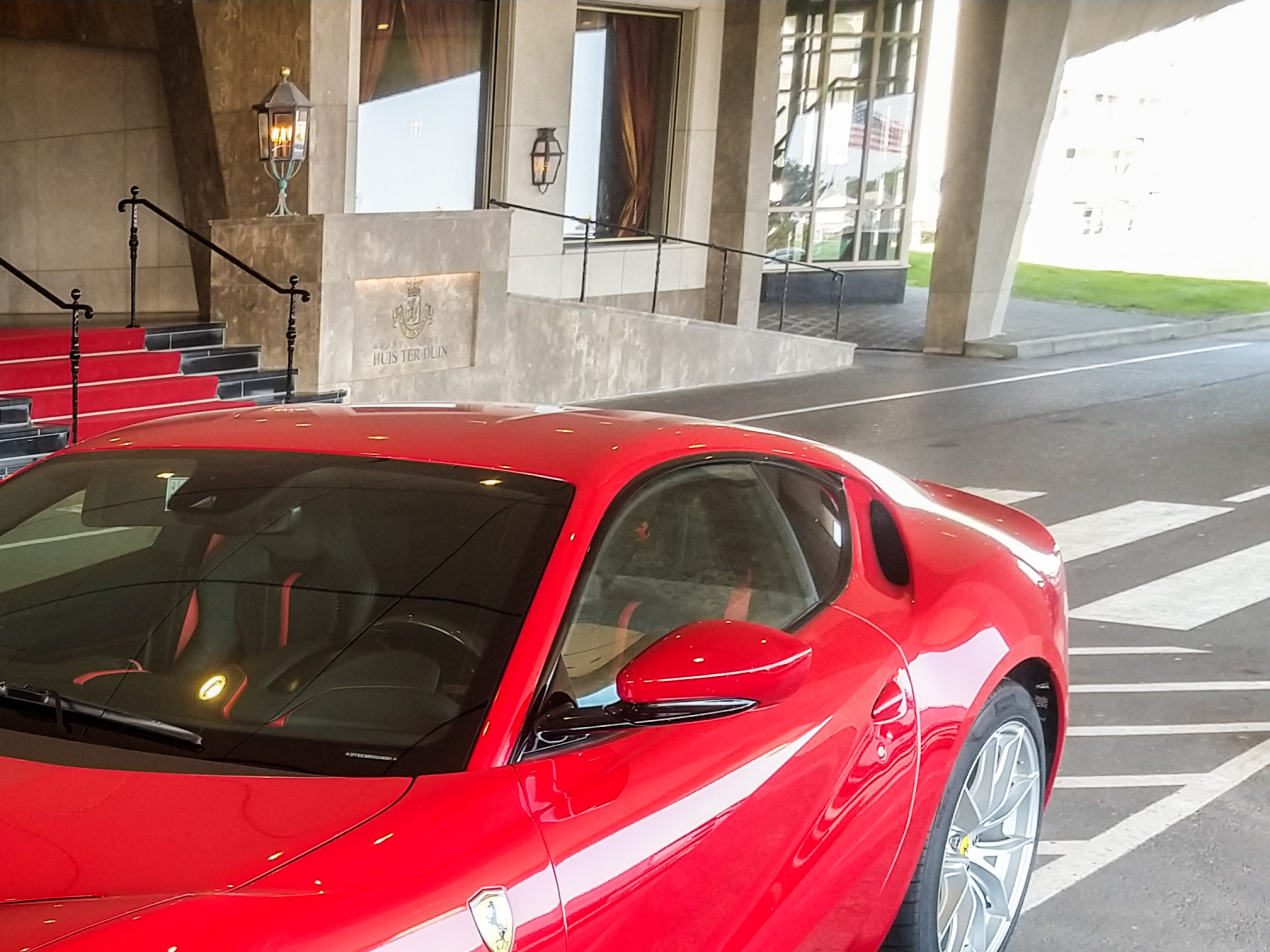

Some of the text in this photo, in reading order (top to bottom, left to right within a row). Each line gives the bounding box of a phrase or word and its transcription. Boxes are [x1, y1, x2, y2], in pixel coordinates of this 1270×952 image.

[373, 345, 448, 366] HUIS TER DUIN
